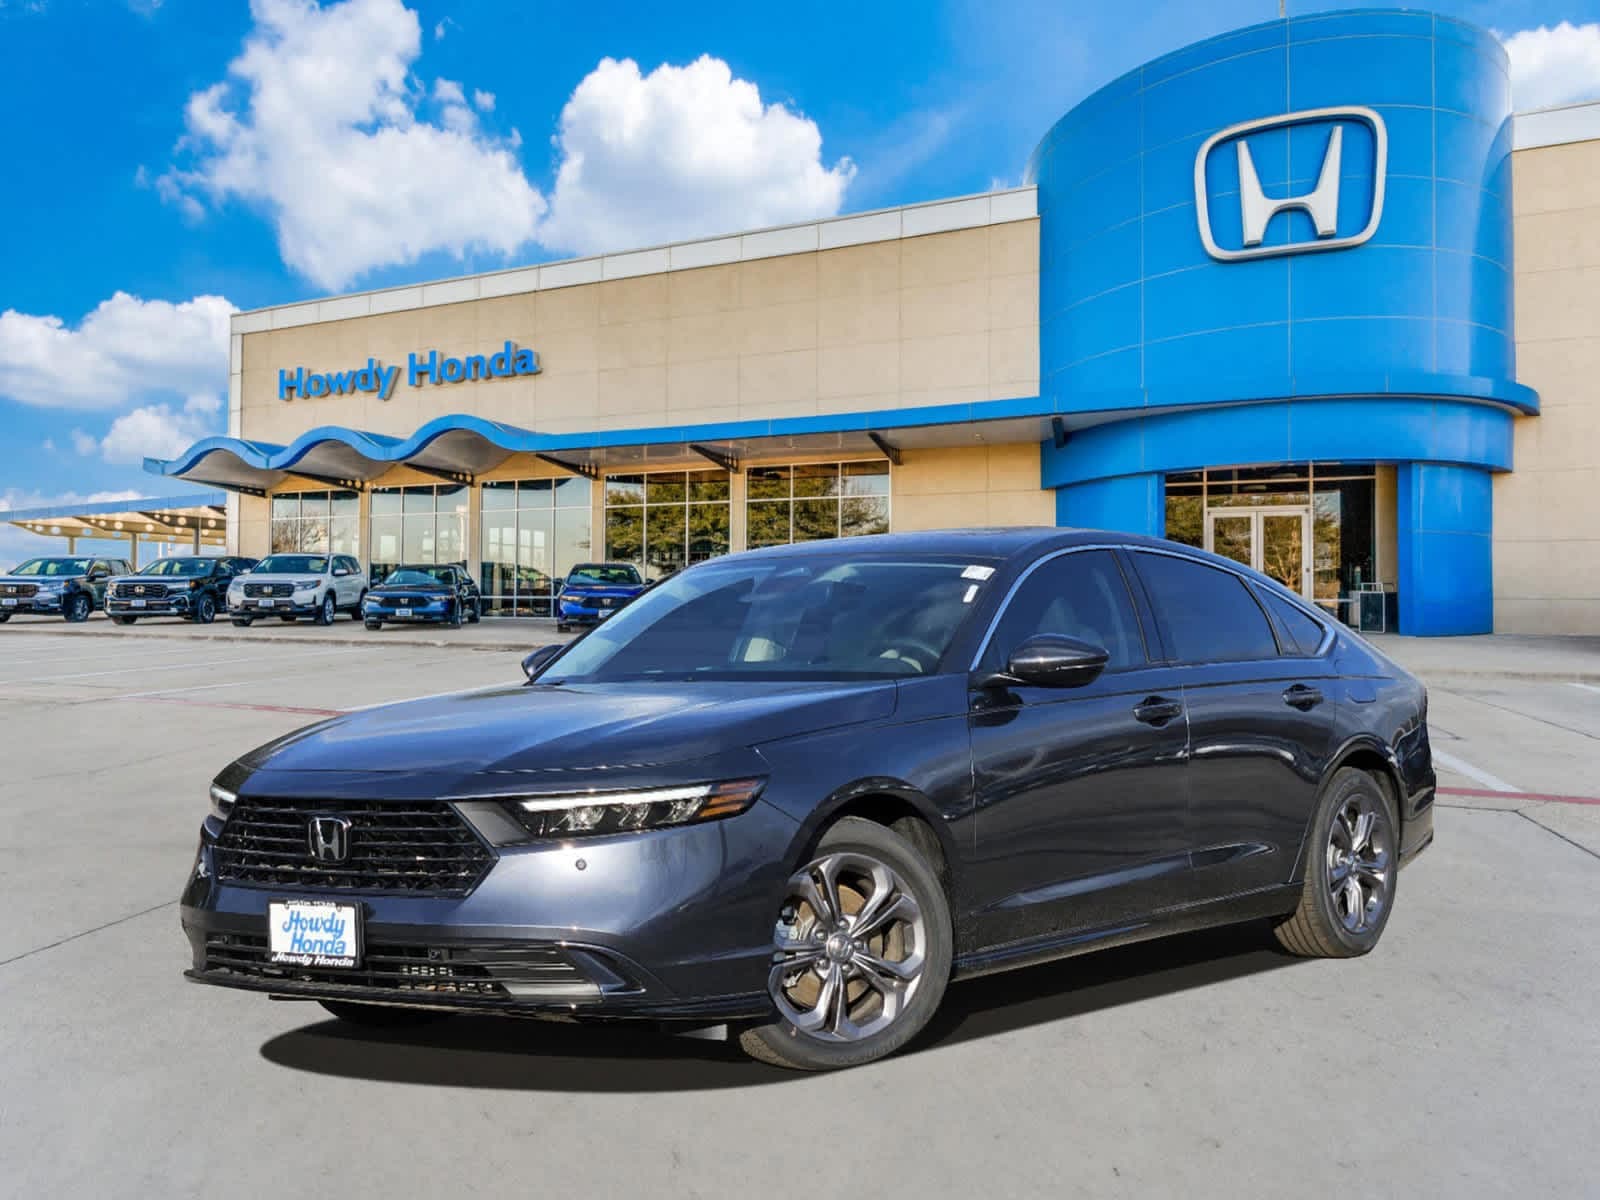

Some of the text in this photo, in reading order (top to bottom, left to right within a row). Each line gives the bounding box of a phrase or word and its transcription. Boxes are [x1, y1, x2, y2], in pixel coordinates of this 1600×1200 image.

[279, 340, 540, 400] Howdy Honda
[282, 909, 346, 939] Howdy
[290, 931, 347, 955] Honda
[271, 952, 313, 966] Howdy
